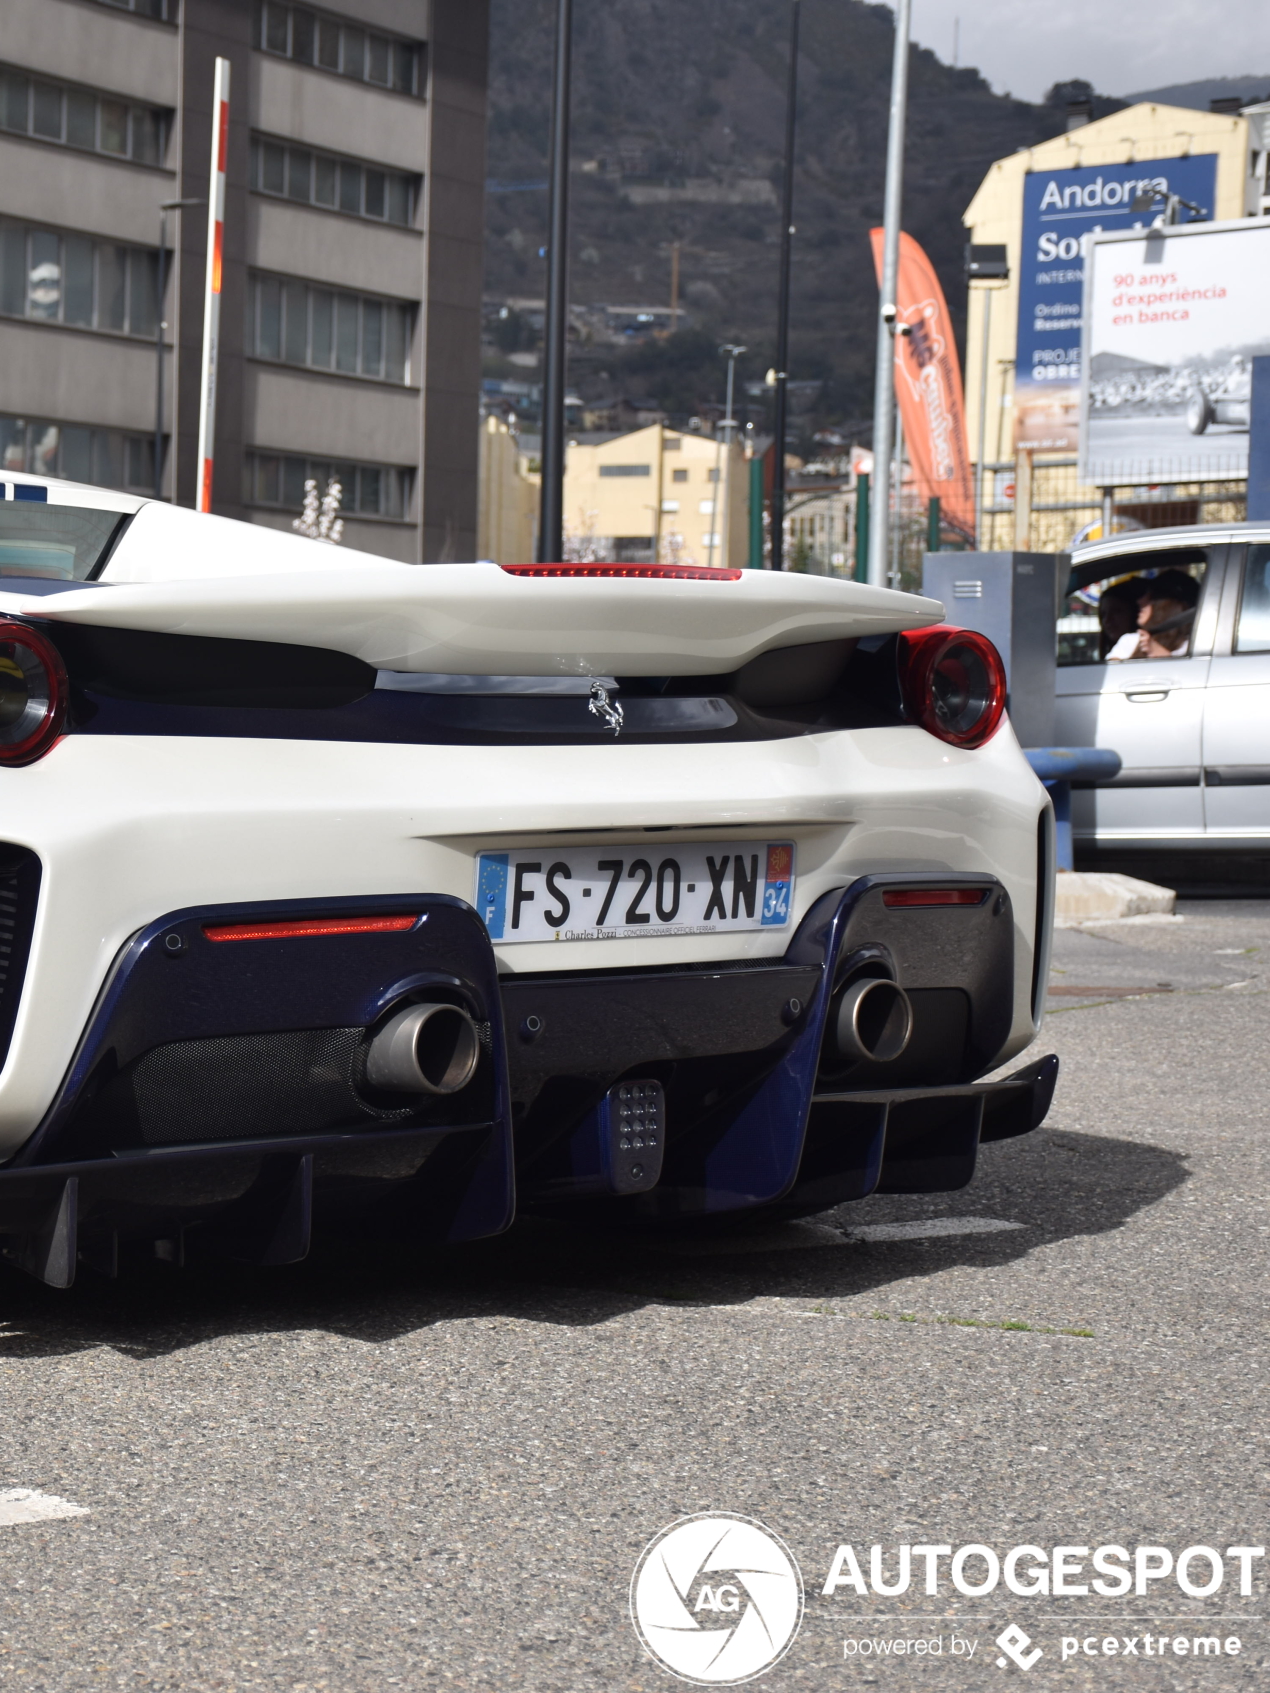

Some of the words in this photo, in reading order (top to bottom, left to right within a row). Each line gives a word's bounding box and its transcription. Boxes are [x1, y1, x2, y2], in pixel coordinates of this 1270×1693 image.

[1039, 176, 1168, 211] Andorra
[1114, 273, 1135, 288] 90
[1138, 272, 1178, 287] anys
[1034, 302, 1080, 318] Ordino
[1112, 313, 1134, 326] en
[1138, 309, 1190, 325] banca
[764, 887, 787, 918] 34
[485, 906, 496, 925] F
[564, 929, 594, 940] Charles
[596, 928, 617, 939] Pozzi
